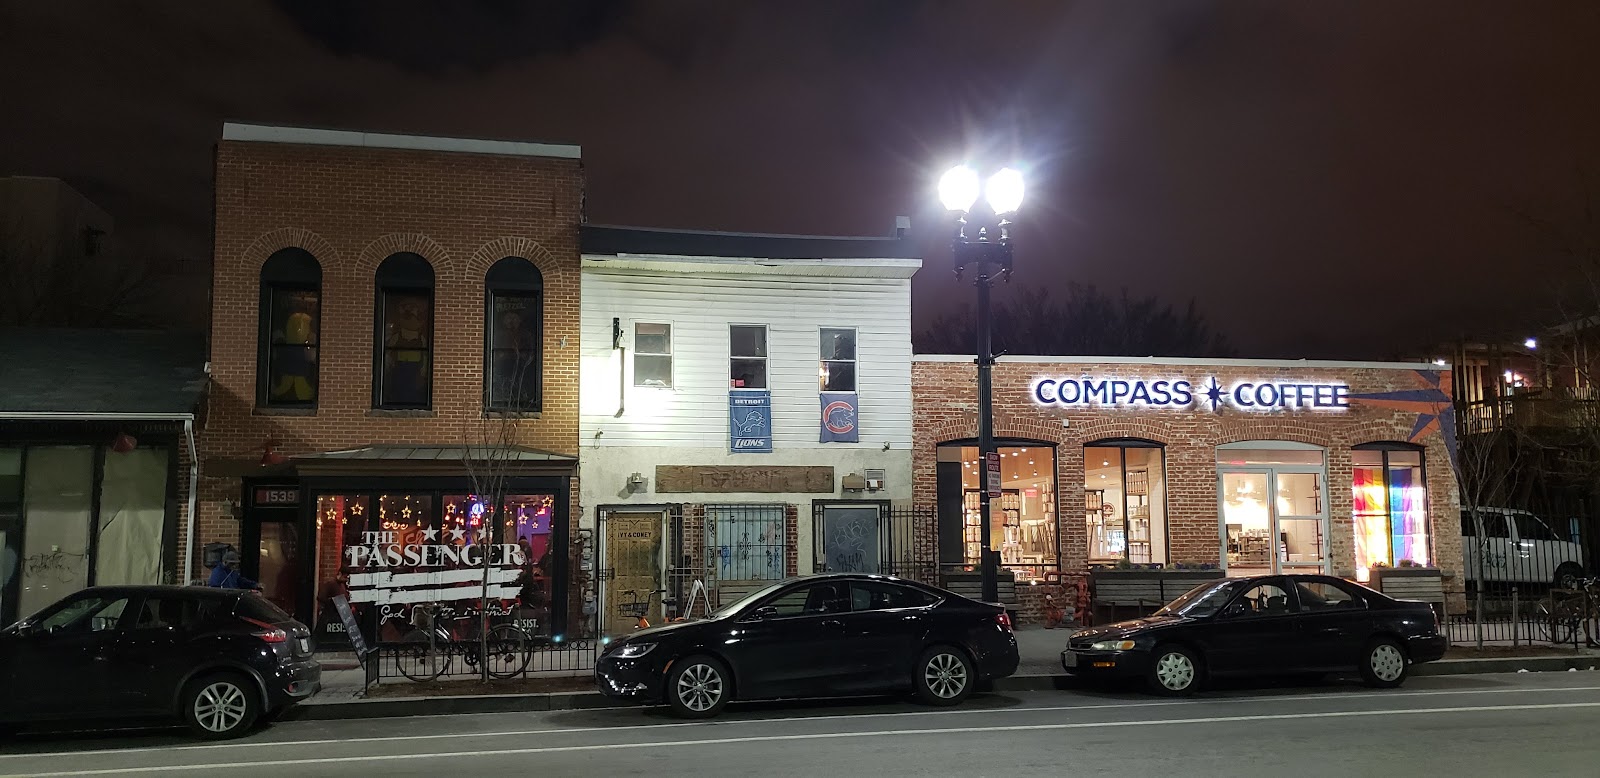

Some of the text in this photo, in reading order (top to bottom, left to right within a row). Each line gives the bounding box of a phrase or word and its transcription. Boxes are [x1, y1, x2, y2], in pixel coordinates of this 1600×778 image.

[1036, 379, 1350, 408] COMPASS COFFEE
[735, 439, 765, 448] LIONS
[265, 490, 295, 502] 1539
[362, 531, 398, 544] THE
[347, 543, 527, 568] PASSENGER
[514, 618, 539, 629] RSIST.
